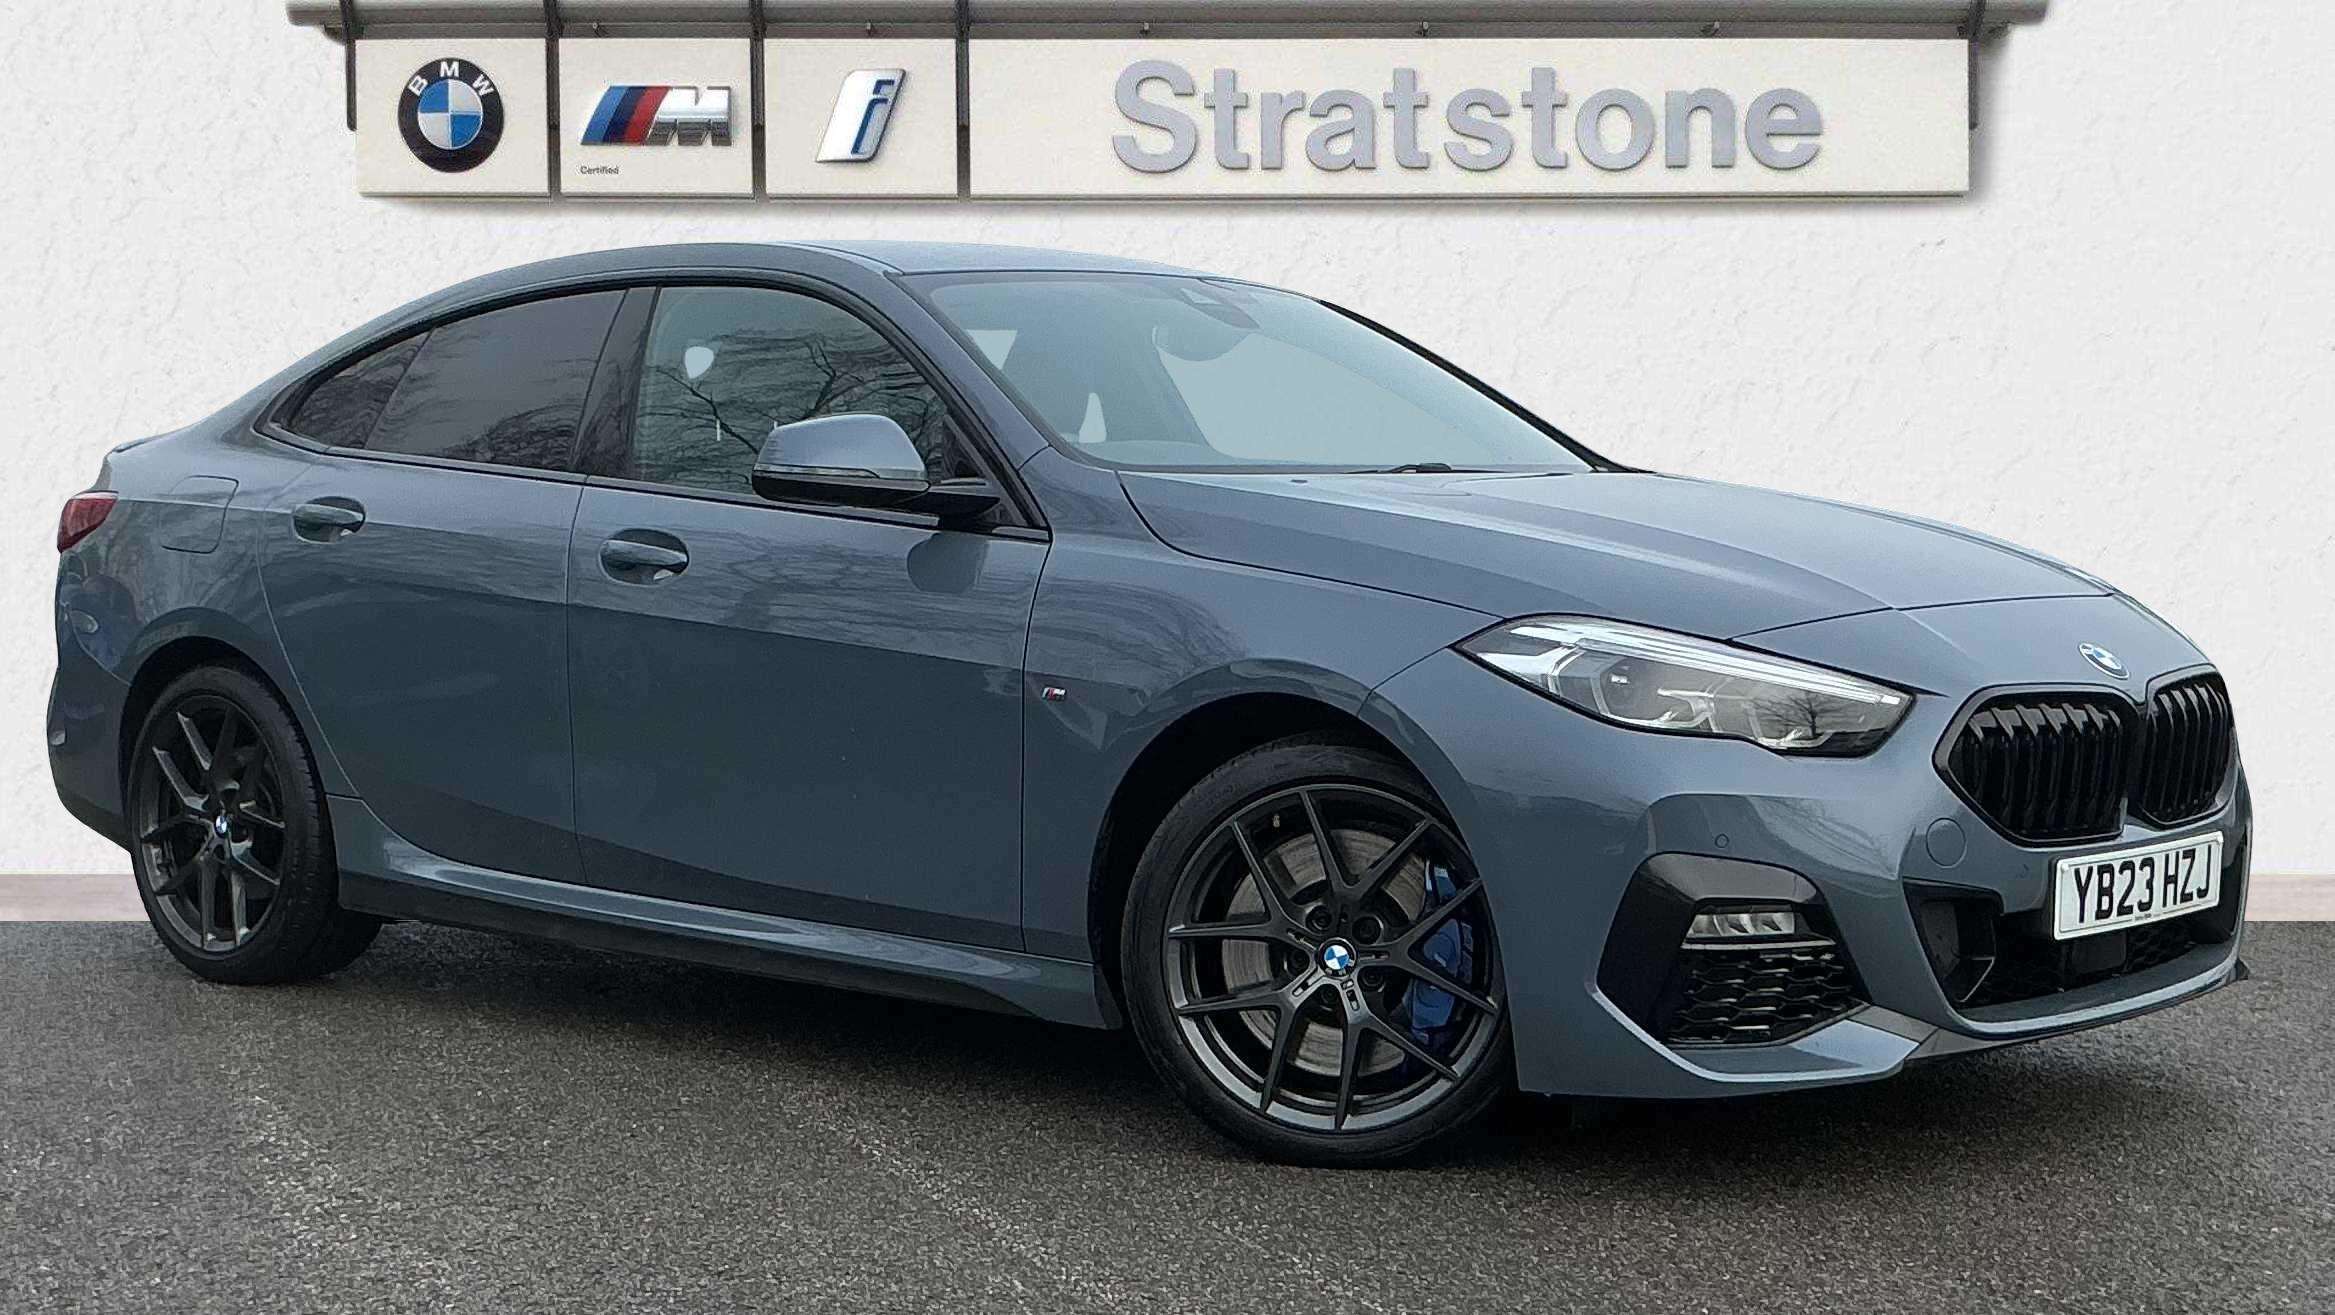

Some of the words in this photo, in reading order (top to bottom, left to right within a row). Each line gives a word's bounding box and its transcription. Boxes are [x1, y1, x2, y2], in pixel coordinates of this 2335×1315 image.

[407, 61, 495, 97] BMW
[1112, 59, 1824, 173] Stratstone
[580, 165, 620, 175] Certified
[2073, 856, 2155, 924] YB23
[2162, 844, 2212, 909] HZJ
